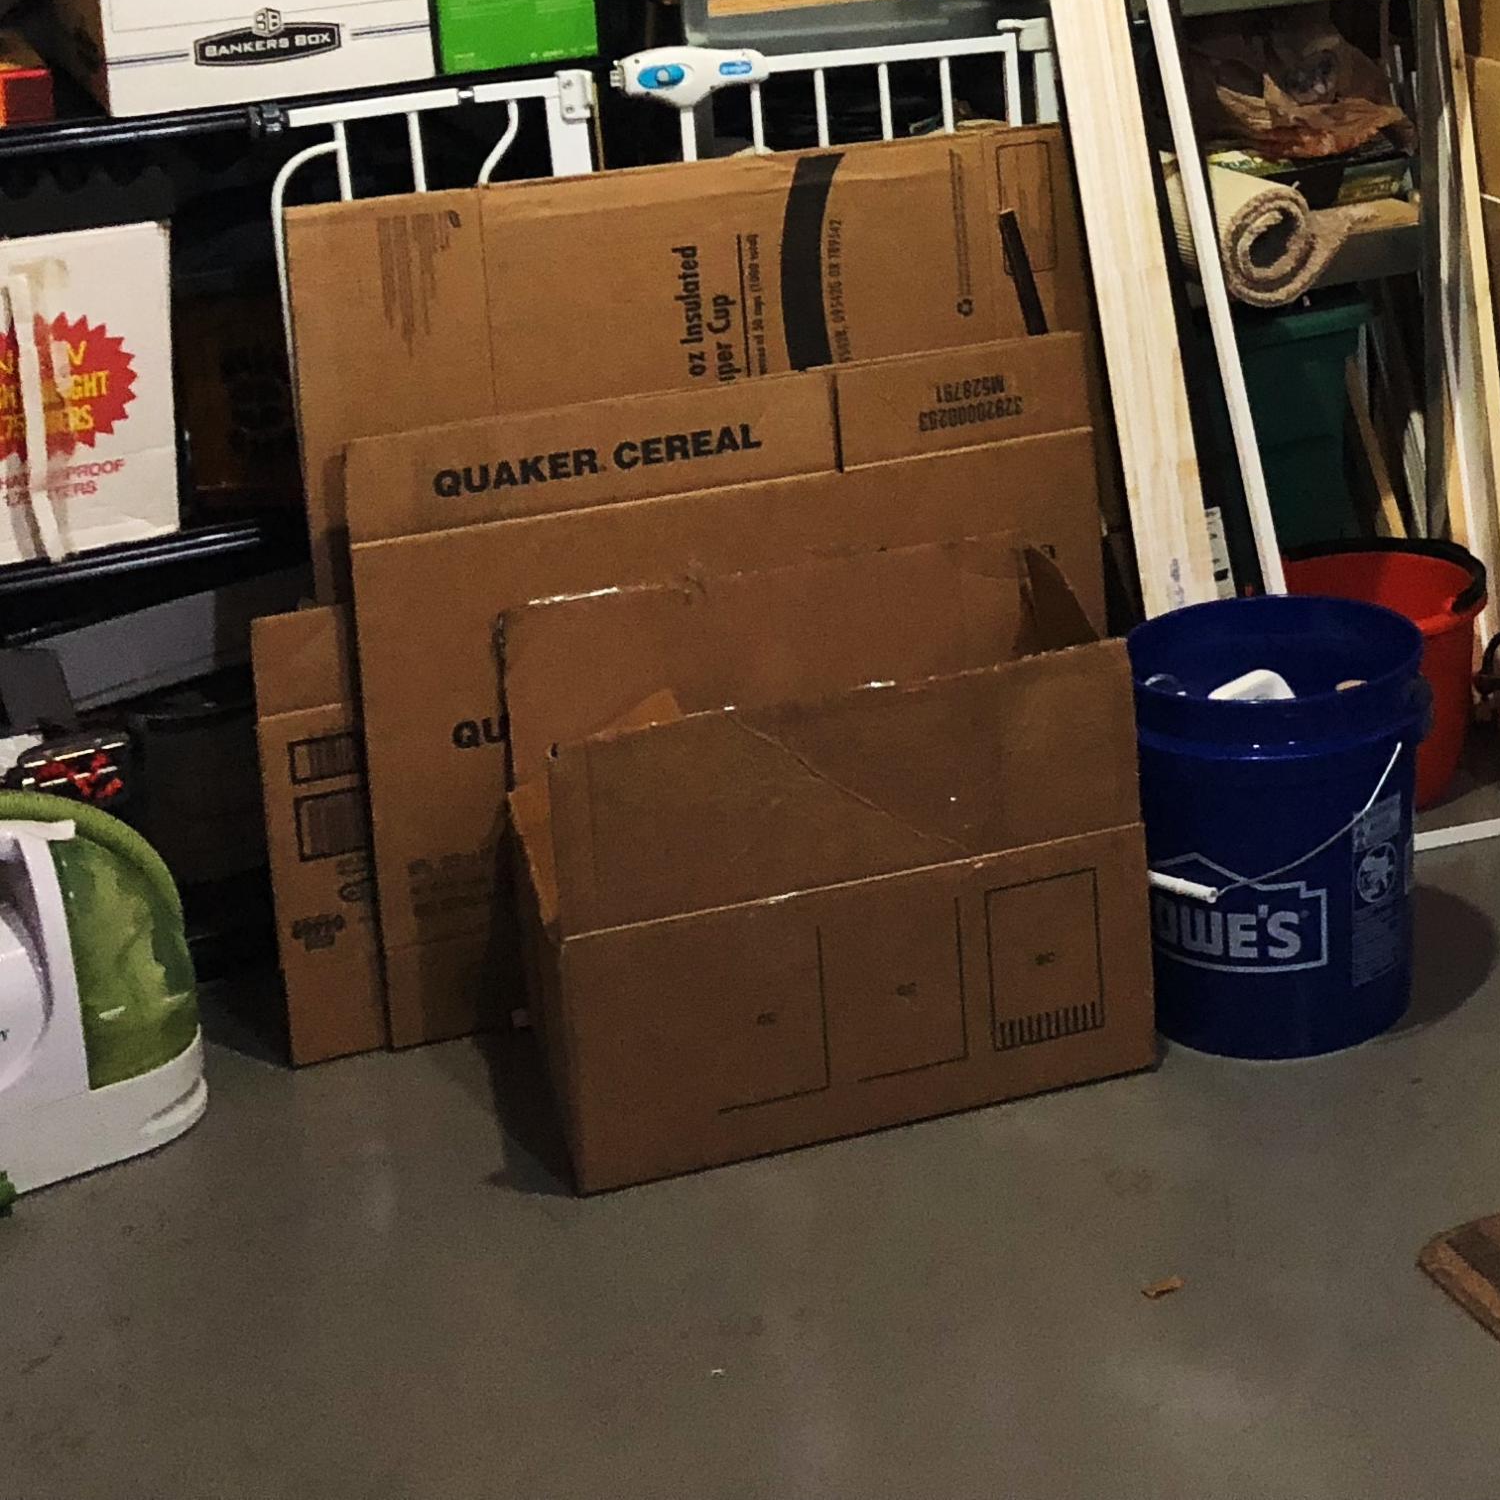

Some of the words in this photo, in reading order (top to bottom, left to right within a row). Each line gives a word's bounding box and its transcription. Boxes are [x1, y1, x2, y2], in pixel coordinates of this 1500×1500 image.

[205, 37, 290, 58] BANKERS
[294, 32, 331, 47] BOX
[672, 245, 704, 345] Insulated
[706, 294, 736, 335] Cup
[688, 351, 707, 378] oz
[433, 447, 600, 499] QUAKER
[613, 423, 762, 471] CEREAL
[1156, 905, 1302, 960] OWE'S
